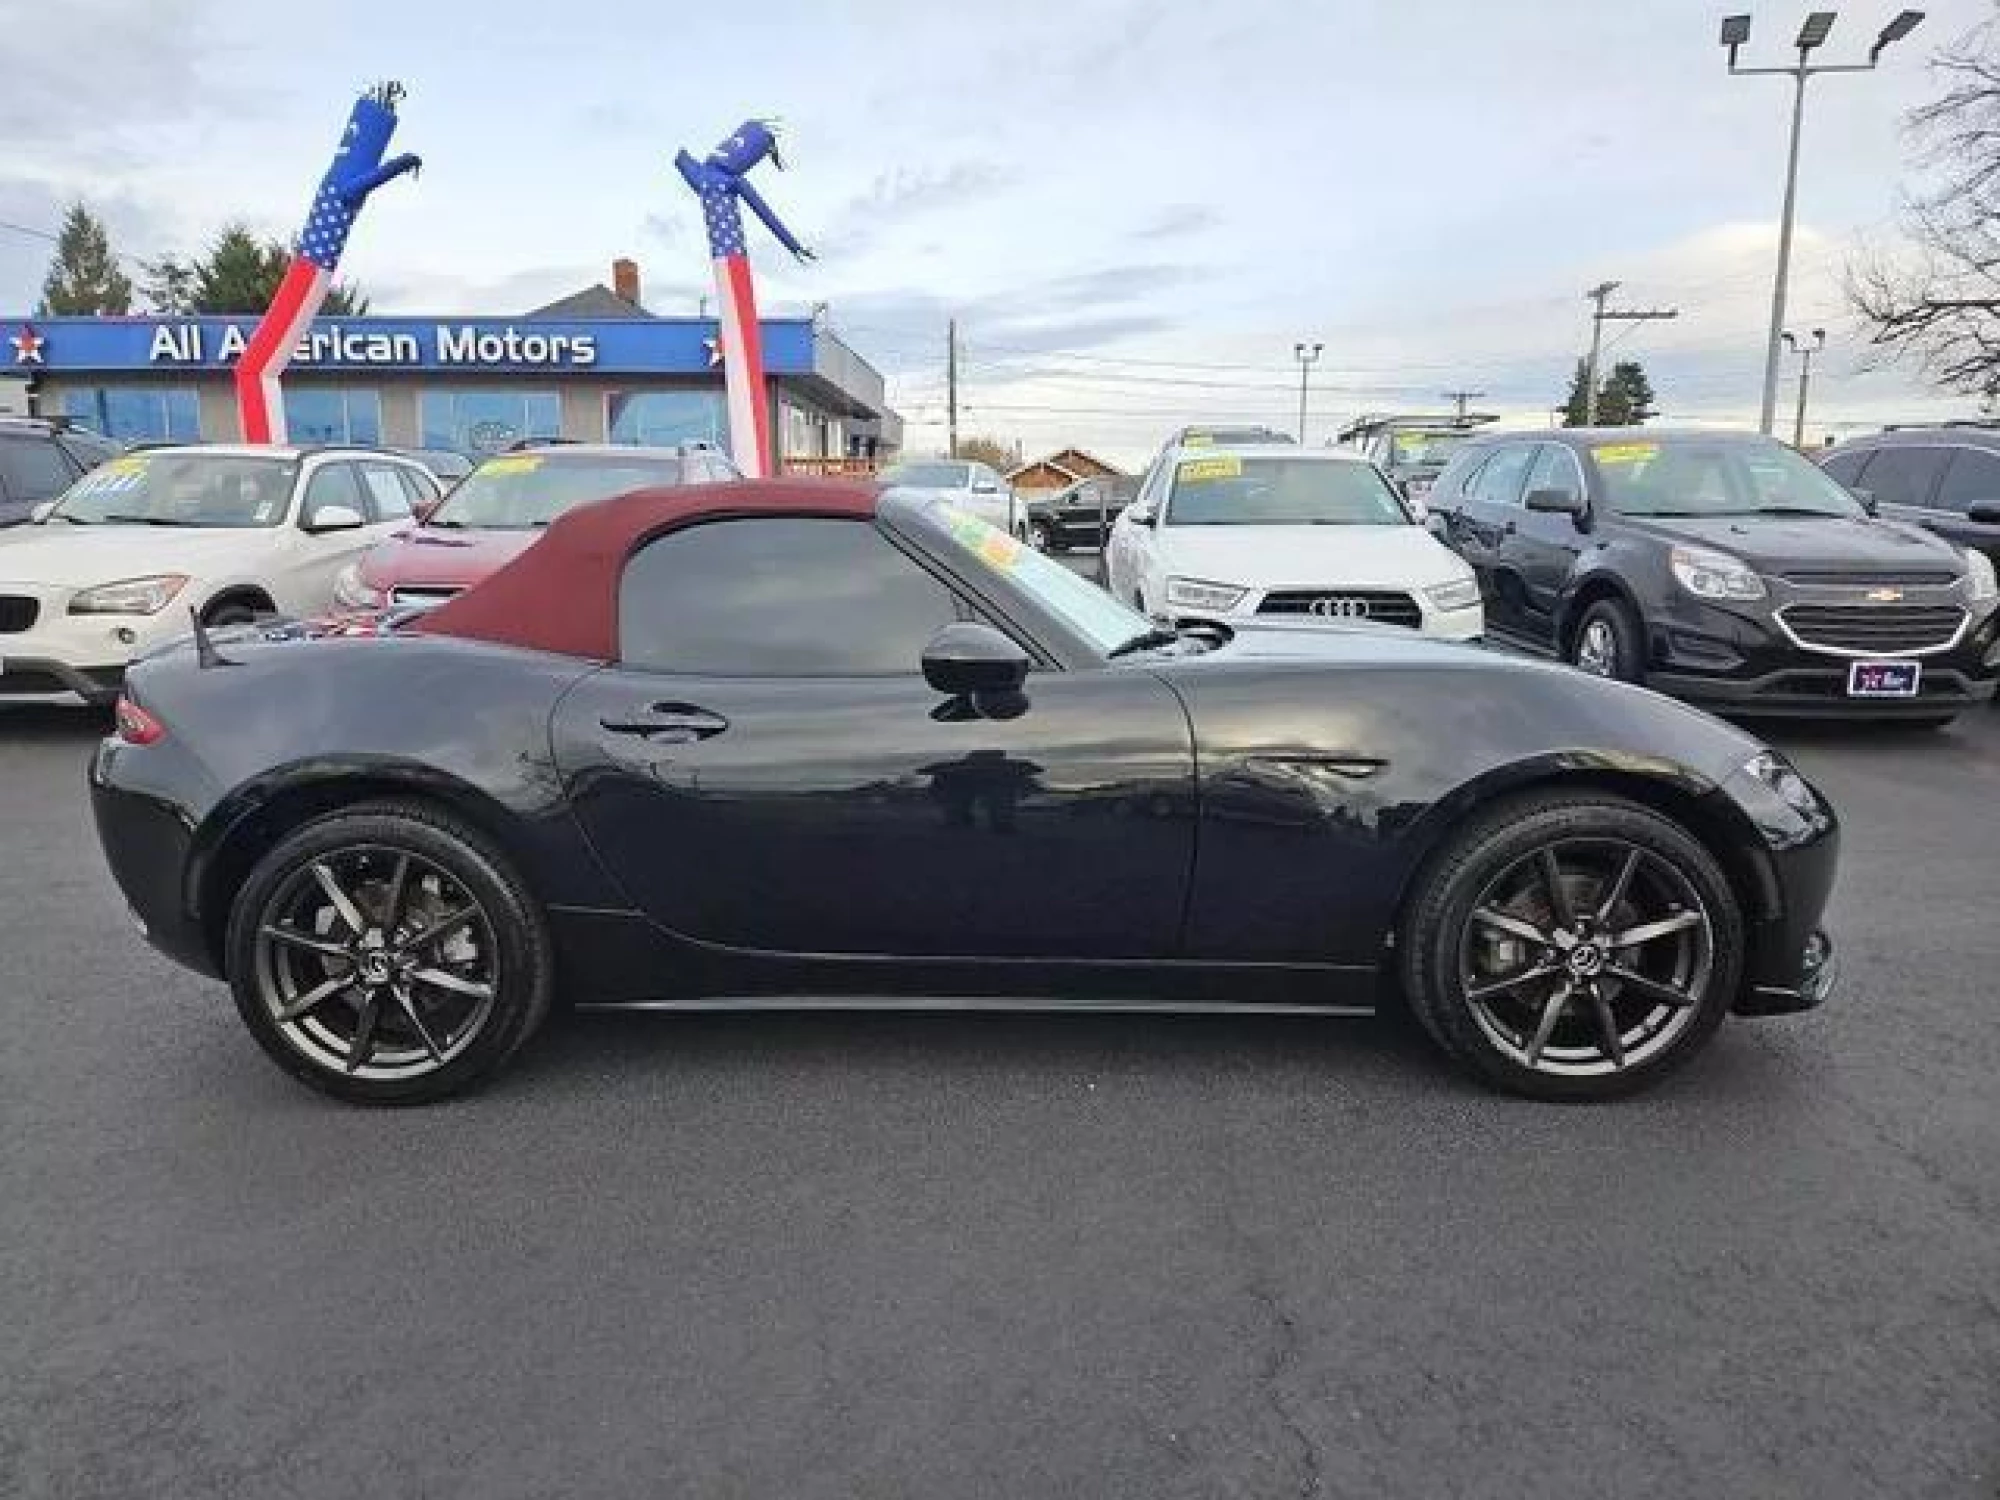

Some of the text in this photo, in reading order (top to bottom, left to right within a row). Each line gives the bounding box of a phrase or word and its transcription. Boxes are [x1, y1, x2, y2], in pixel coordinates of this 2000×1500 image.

[149, 324, 595, 363] All Aerican Motors
